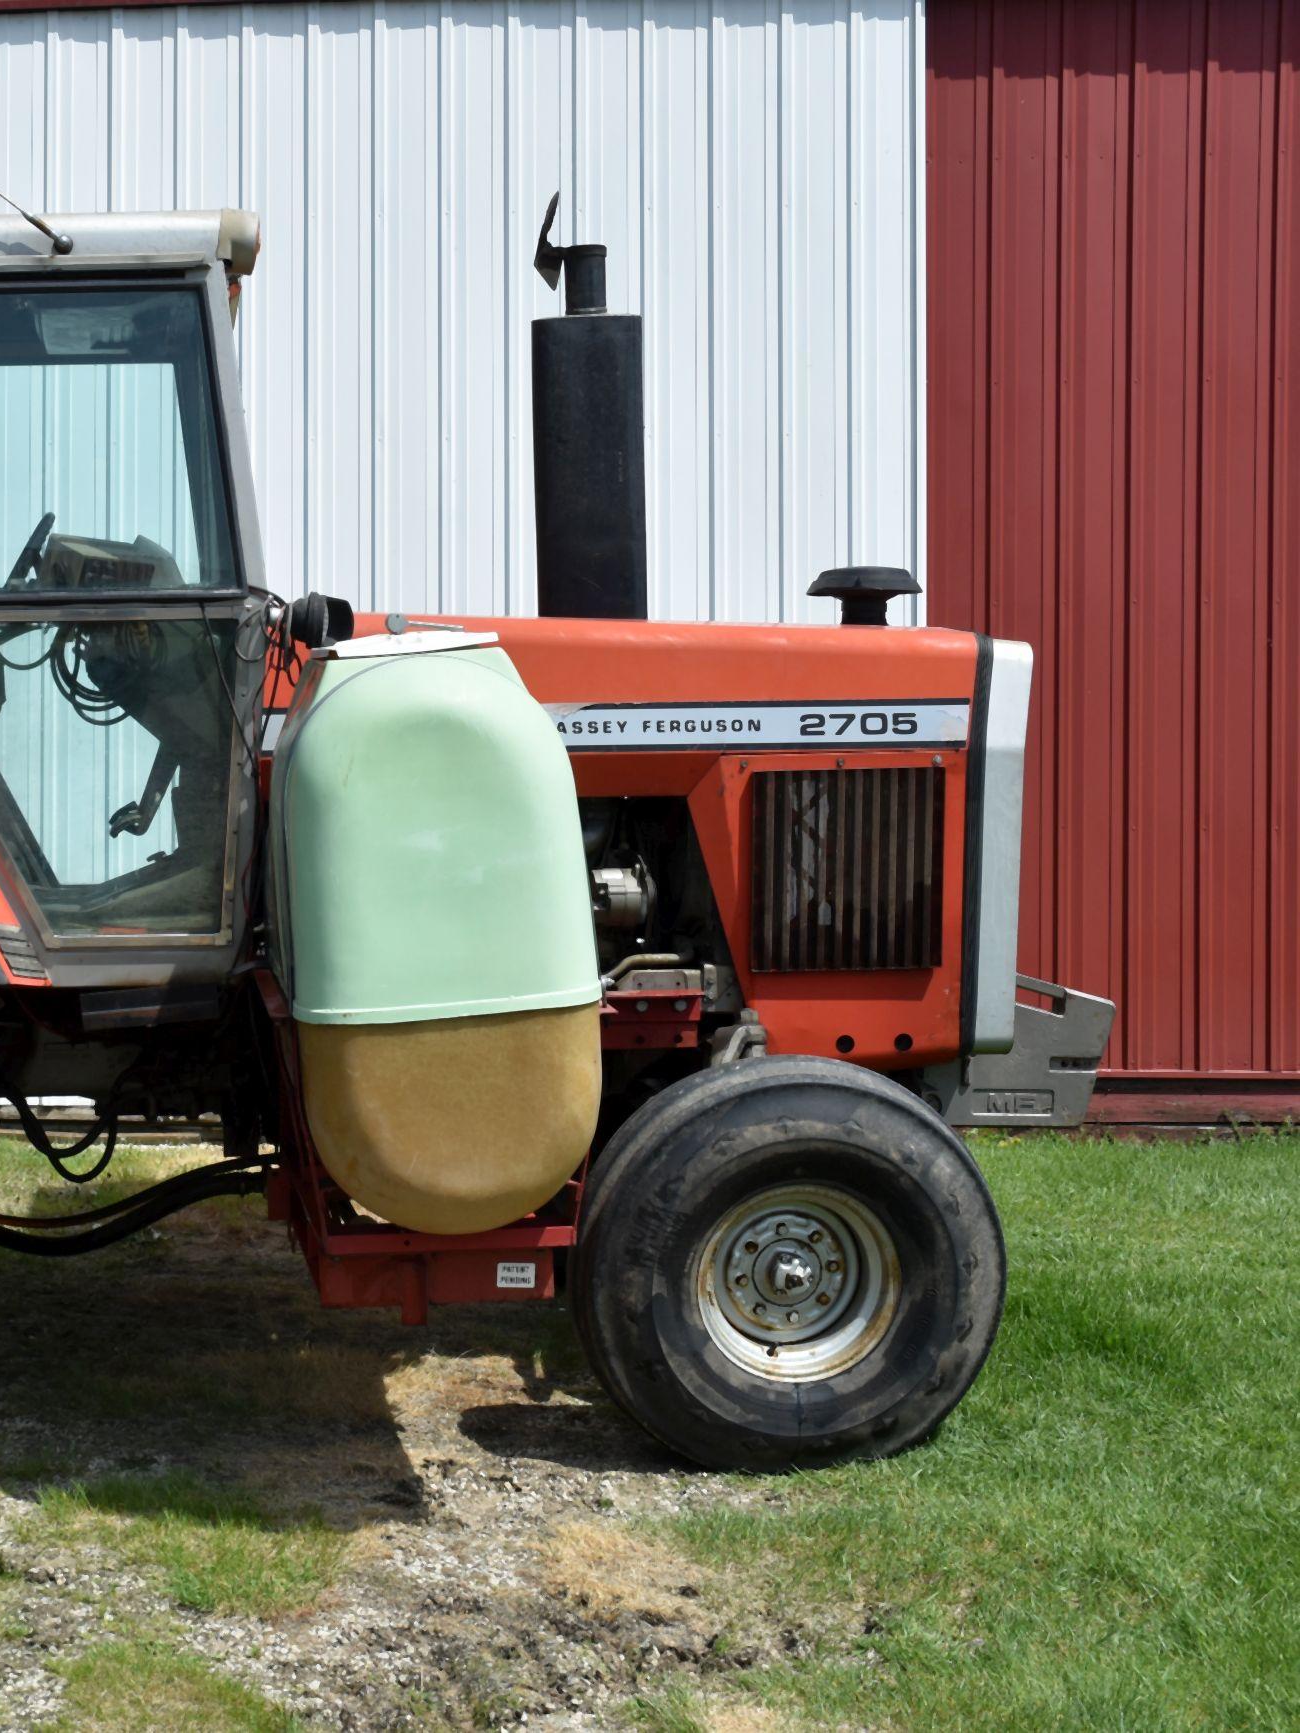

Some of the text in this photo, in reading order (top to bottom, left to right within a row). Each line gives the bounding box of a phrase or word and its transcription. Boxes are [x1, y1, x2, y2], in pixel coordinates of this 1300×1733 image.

[557, 712, 918, 736] ASSEY FERGUSON 2705
